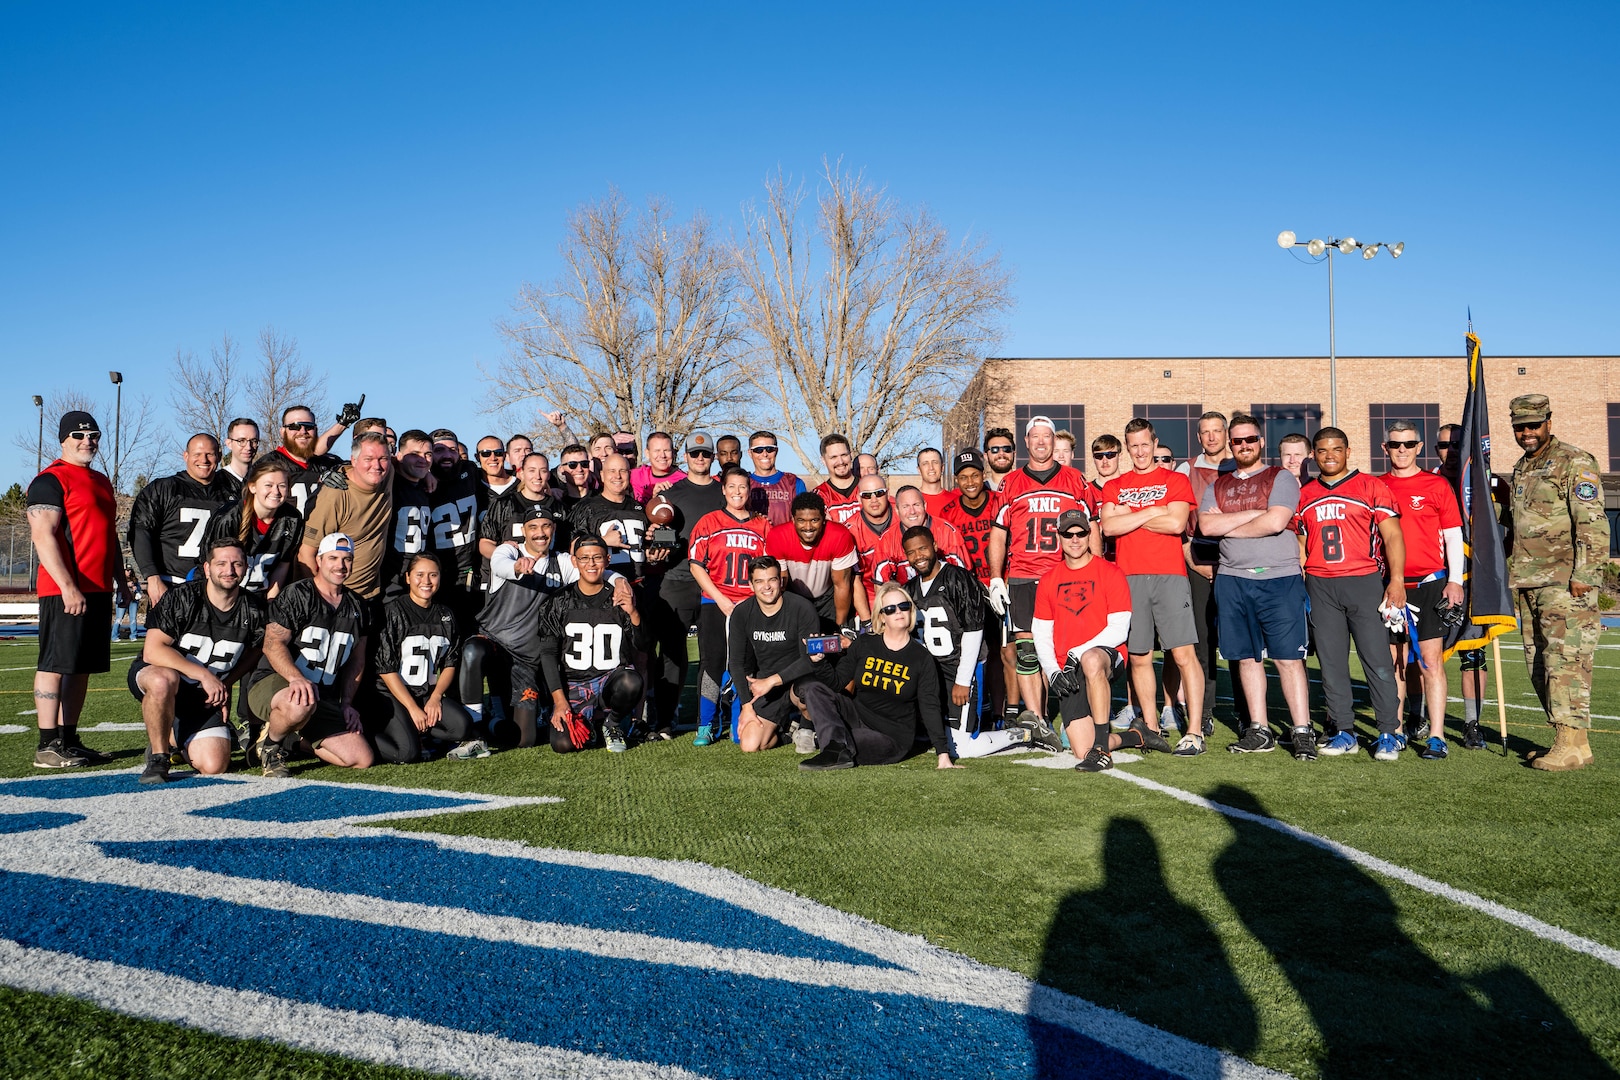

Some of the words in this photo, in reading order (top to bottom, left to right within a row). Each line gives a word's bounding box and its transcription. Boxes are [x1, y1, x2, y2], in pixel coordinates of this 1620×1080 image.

[431, 494, 478, 550] 27
[1027, 496, 1061, 513] NNC
[1314, 503, 1346, 522] NNC
[177, 507, 211, 558] 7
[725, 533, 758, 551] NNC
[1025, 517, 1061, 553] 15
[1321, 525, 1345, 564] 8
[722, 551, 755, 588] 10
[294, 625, 355, 686] 20
[564, 621, 623, 671] 30
[861, 671, 905, 695] CITY
[864, 656, 911, 681] STEEL
